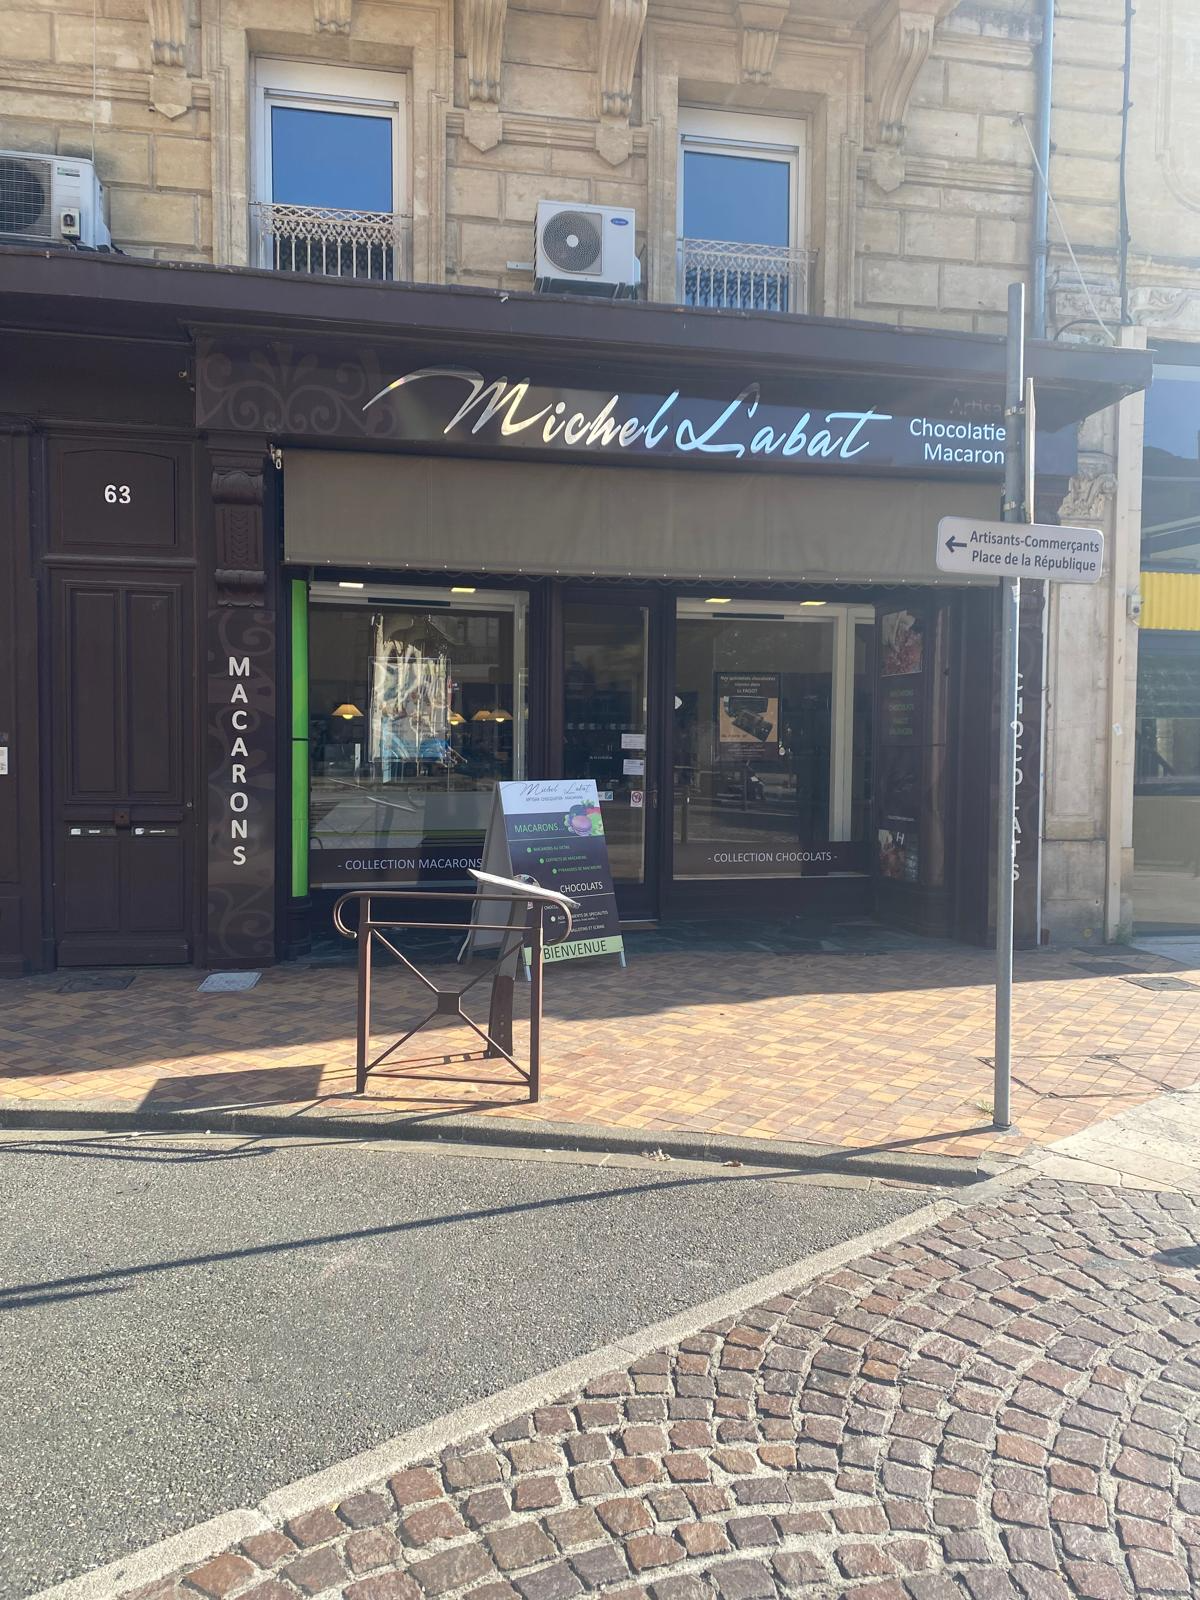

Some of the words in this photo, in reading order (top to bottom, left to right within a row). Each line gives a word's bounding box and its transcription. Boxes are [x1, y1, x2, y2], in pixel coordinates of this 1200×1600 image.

[362, 366, 678, 449] Michel
[674, 382, 892, 459] Labat
[949, 397, 1003, 417] Artisa
[909, 418, 1006, 441] Chocolatie
[924, 443, 1005, 464] Macaron
[104, 484, 132, 504] 63
[970, 530, 1100, 554] Artisants-Commerçants
[971, 550, 1002, 565] Place
[1004, 551, 1019, 566] de
[1021, 553, 1032, 566] la
[1034, 554, 1097, 573] République
[228, 656, 250, 867] MACARONS
[345, 858, 416, 871] COLLECTION
[418, 857, 482, 870] MACARONS
[714, 851, 773, 863] COLLECTION
[775, 850, 832, 863] CHOCOLATS
[560, 881, 603, 894] CHOCOLATS
[543, 939, 607, 960] BIENVENUE
